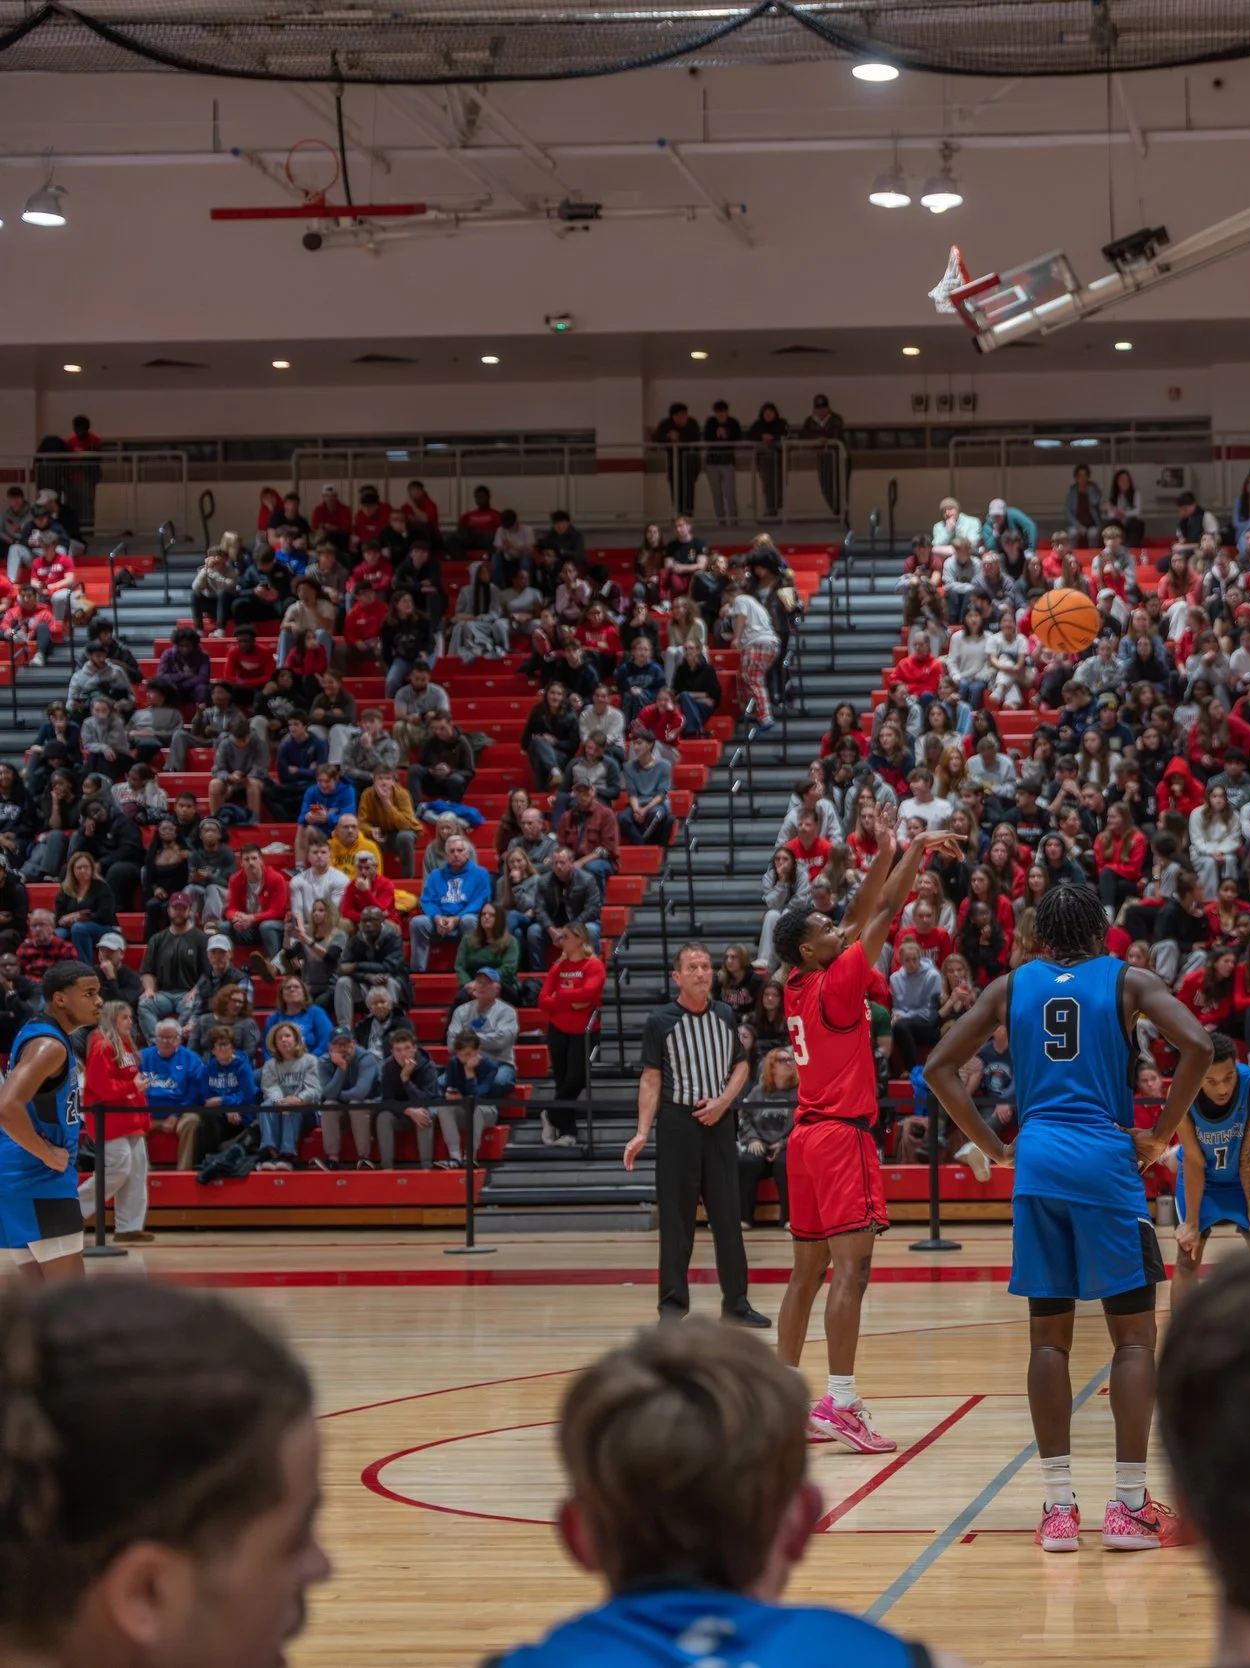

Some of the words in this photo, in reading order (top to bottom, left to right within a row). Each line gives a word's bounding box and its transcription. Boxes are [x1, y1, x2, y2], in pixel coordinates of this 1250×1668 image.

[787, 1016, 810, 1066] 3
[1043, 997, 1080, 1061] 9
[1214, 1147, 1228, 1170] 1
